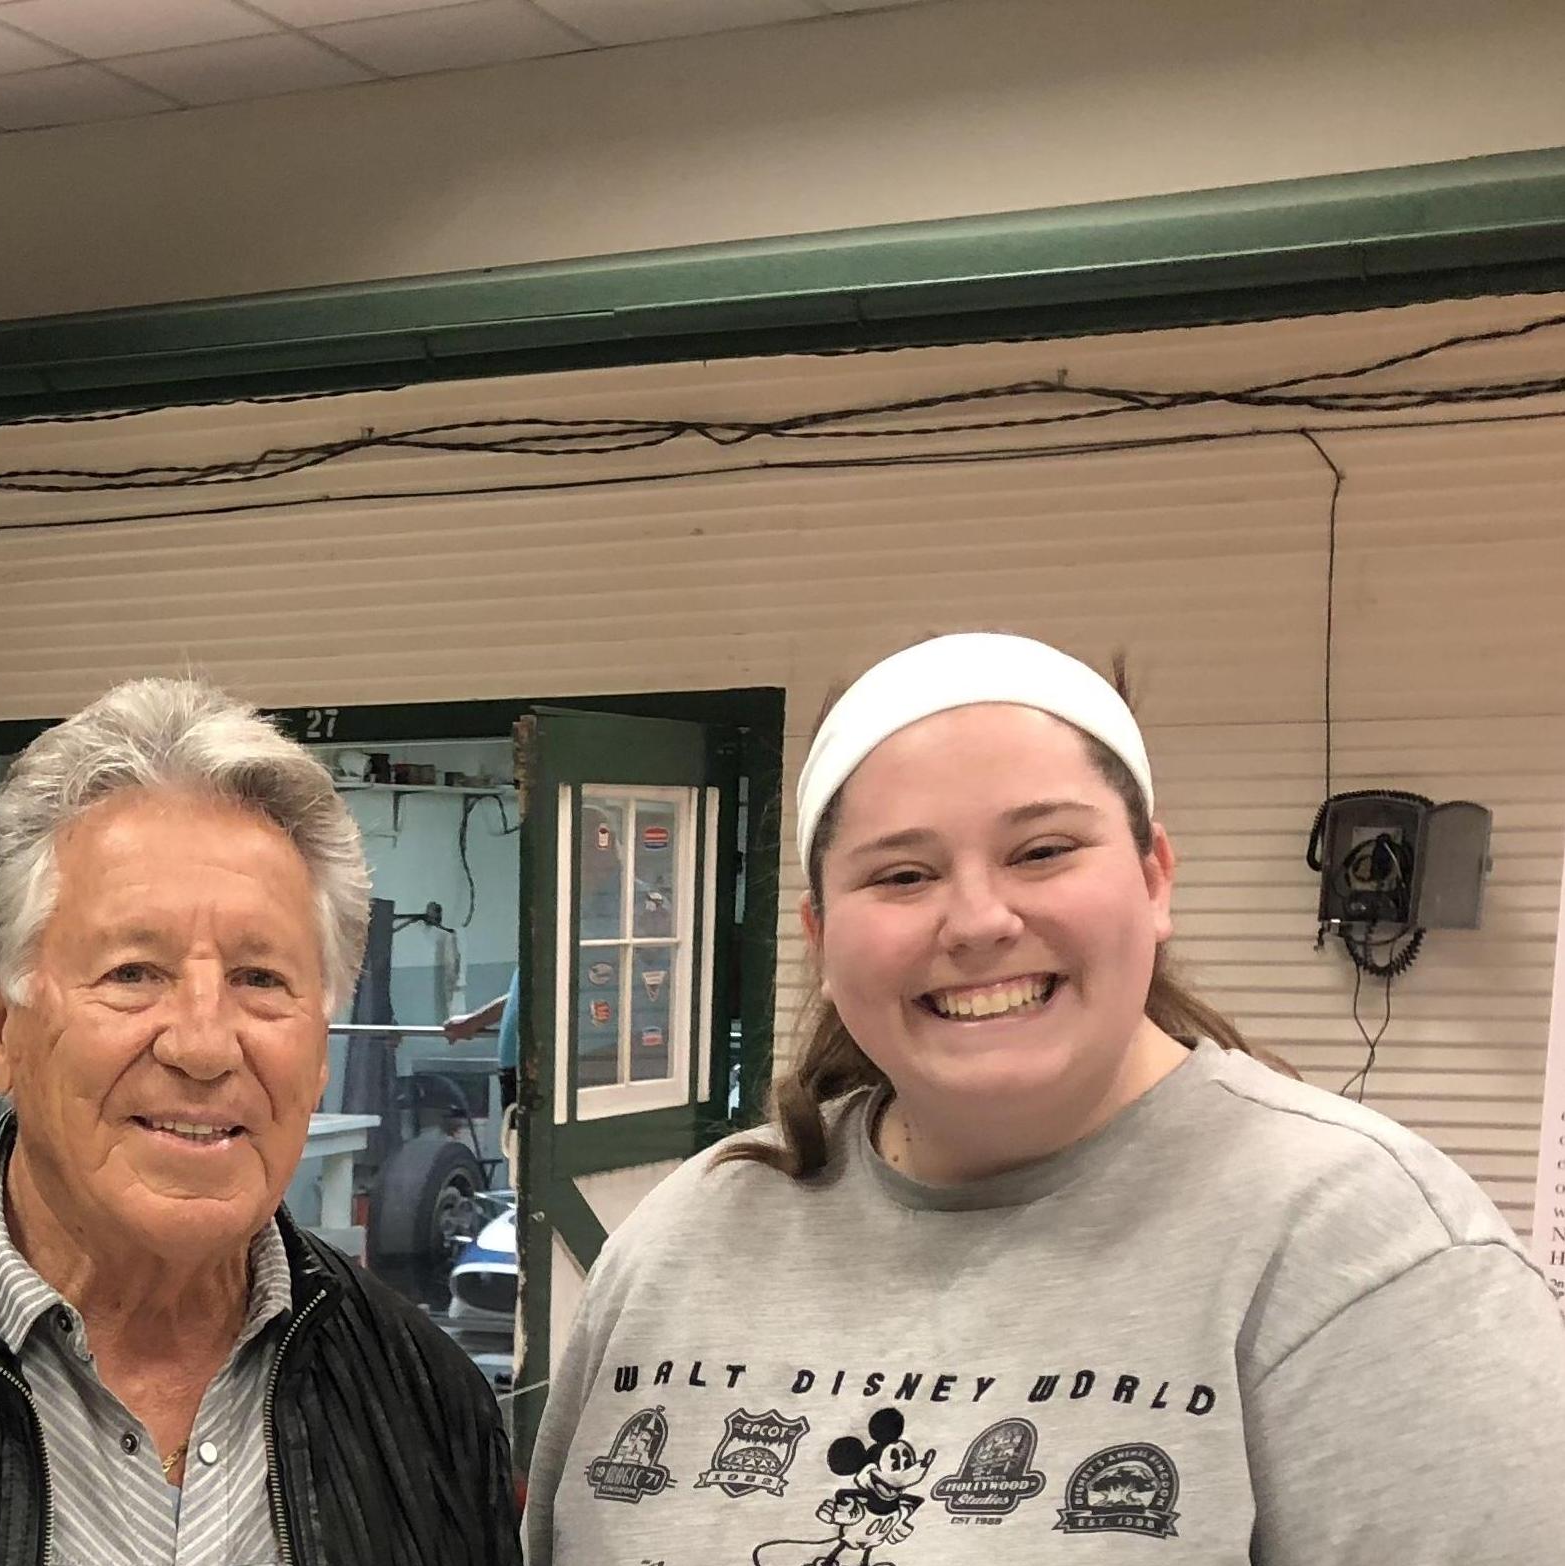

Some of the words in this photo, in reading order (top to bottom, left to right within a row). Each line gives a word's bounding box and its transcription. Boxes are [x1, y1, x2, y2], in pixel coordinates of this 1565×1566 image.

[306, 708, 339, 739] 27
[614, 1360, 747, 1393] WALT
[791, 1368, 997, 1402] DISNEY
[1027, 1369, 1217, 1416] WORLD
[742, 1422, 789, 1438] EPCOT
[945, 1480, 1030, 1492] HOLLYWOOD
